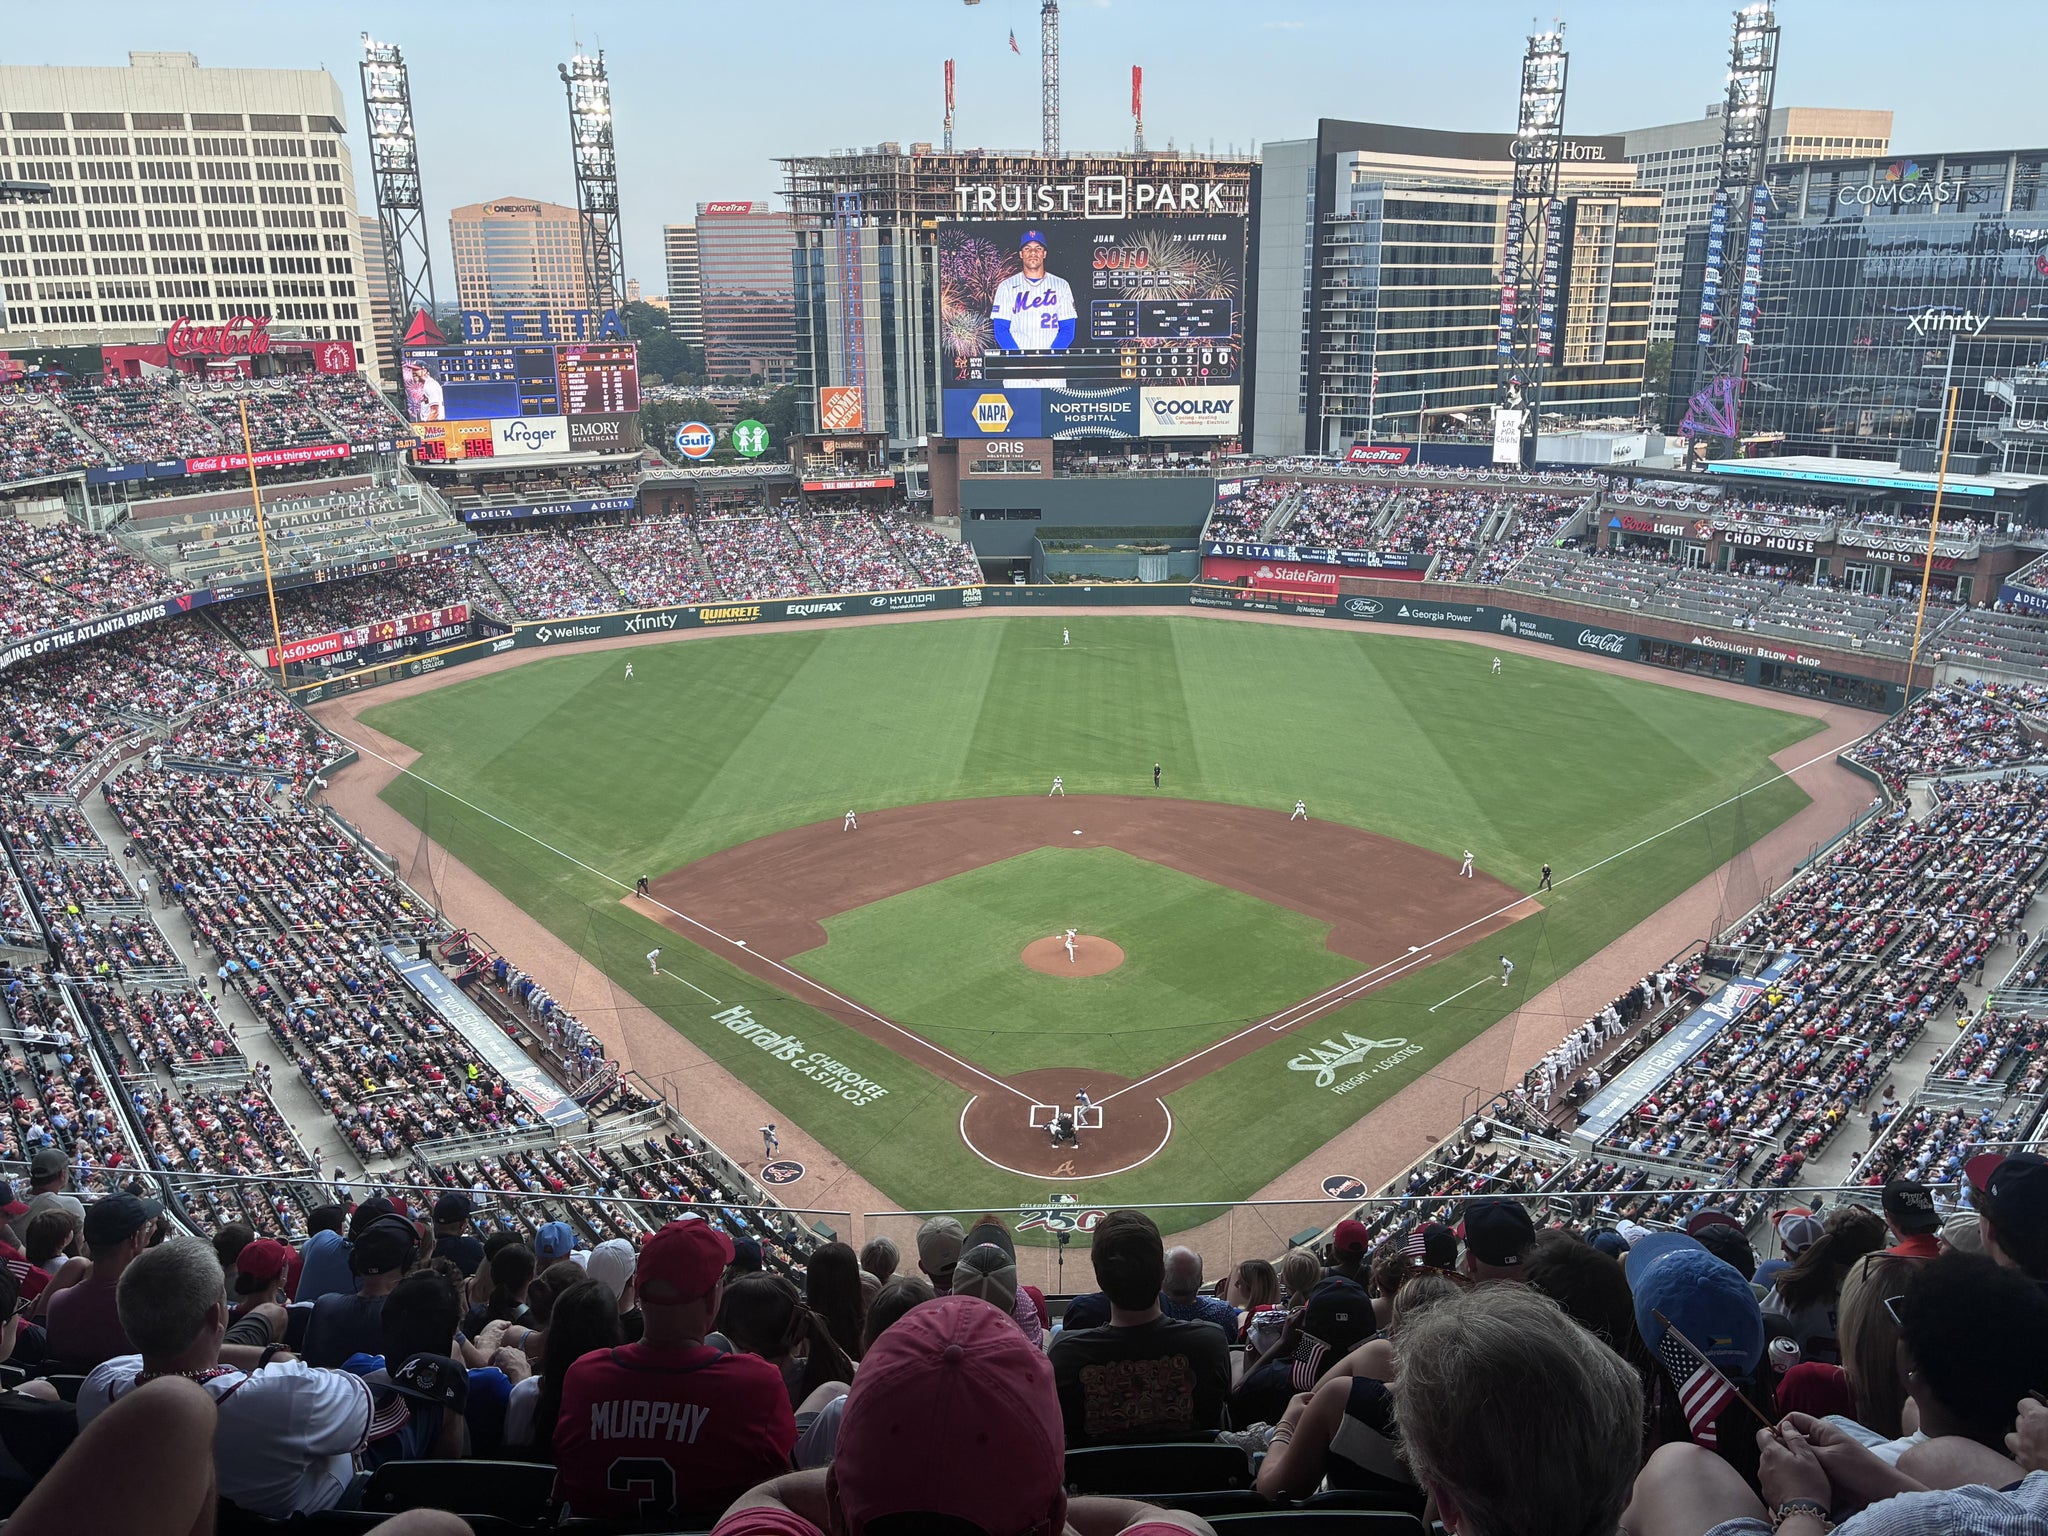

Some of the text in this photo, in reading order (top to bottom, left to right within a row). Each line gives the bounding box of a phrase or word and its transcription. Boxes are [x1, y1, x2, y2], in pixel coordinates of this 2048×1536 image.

[1562, 141, 1606, 160] HOTEL
[954, 182, 1225, 213] TRUIST PARK
[1838, 181, 1966, 206] COMCAST
[493, 204, 541, 214] ONEDIGITAL
[710, 203, 747, 213] RaceTrac
[1093, 235, 1115, 243] JUAN
[1093, 246, 1150, 270] SOTO
[1012, 288, 1057, 315] Mets
[462, 309, 626, 341] DELTA
[1040, 312, 1059, 329] 22
[1906, 308, 1991, 337] xfinity
[166, 315, 273, 357] Coca-Cola
[1125, 356, 1193, 365] 0 0 0 0 2
[1203, 352, 1228, 365] 0 0
[1125, 368, 1193, 376] 0 0 0 0 2
[822, 386, 861, 428] HOME
[827, 391, 841, 409] THE
[1153, 399, 1234, 415] COOLRAY
[978, 403, 1007, 422] NAPA
[1050, 402, 1132, 413] NORTHSIDE
[838, 404, 861, 428] DEPOT
[1064, 413, 1117, 422] HOSPITAL
[424, 426, 446, 435] MEGA
[570, 421, 620, 437] EMORY
[1502, 420, 1515, 428] EAT
[504, 420, 557, 451] Kroger
[1500, 427, 1516, 436] MOR
[466, 439, 493, 451] 396
[571, 434, 620, 444] HEALTHCARE
[678, 434, 711, 446] Gulf
[364, 443, 374, 452] PM
[986, 441, 1024, 454] ORIS
[230, 455, 247, 467] Fan
[274, 453, 282, 461] is
[283, 447, 313, 462] thirsty
[316, 447, 336, 458] work
[1351, 449, 1402, 461] RaceTrac
[192, 458, 218, 472] Coca-Cola
[821, 480, 876, 489] THE HOME DEPOT
[539, 504, 573, 514] DELTA
[598, 499, 630, 510] DELTA
[481, 508, 513, 519] DELTA
[1622, 515, 1685, 536] Coors LIGHT
[1724, 531, 1815, 553] CHOP HOUSE
[1226, 545, 1270, 558] DELTA
[1274, 547, 1286, 558] NL
[1866, 549, 1895, 563] MADE
[1897, 552, 1911, 563] TO
[889, 593, 936, 606] HYUNDAI
[962, 588, 982, 597] PAPA
[962, 594, 982, 603] JOHNS
[786, 602, 843, 616] EQUIFAX
[1350, 599, 1377, 613] Ford
[2023, 594, 2048, 610] DELT
[700, 605, 761, 620] QUIKRETE
[1302, 605, 1326, 615] National
[1412, 609, 1473, 623] Georgia Power
[33, 637, 51, 654] OF
[51, 631, 76, 649] THE
[77, 618, 126, 642] ATLANTA
[127, 604, 166, 625] BRAVES
[624, 611, 678, 633] xfinity
[1519, 621, 1537, 630] KAISER
[442, 625, 465, 638] MLB+
[553, 624, 602, 639] Wellstar
[1519, 628, 1553, 641] PERMANENTE
[305, 638, 338, 654] SOUTH
[343, 634, 356, 646] AL
[1578, 629, 1628, 653] Coca-Cola
[330, 650, 359, 664] MLB+
[1702, 635, 1821, 668] Coors LIGHT BELOW CHOP
[421, 656, 440, 665] SOUTH
[422, 659, 445, 670] COLLEGE
[440, 993, 490, 1041] TRUIST PARK
[1287, 1030, 1408, 1088] SAIA
[1625, 1039, 1691, 1092] TRUIST PARK
[808, 1052, 890, 1100] CHEROKEE
[1330, 1043, 1424, 1096] FREIGHT LOGISTICS
[790, 1059, 873, 1107] CASINOS
[394, 1358, 421, 1379] A
[590, 1399, 710, 1444] MURPHY
[607, 1456, 679, 1520] 3
